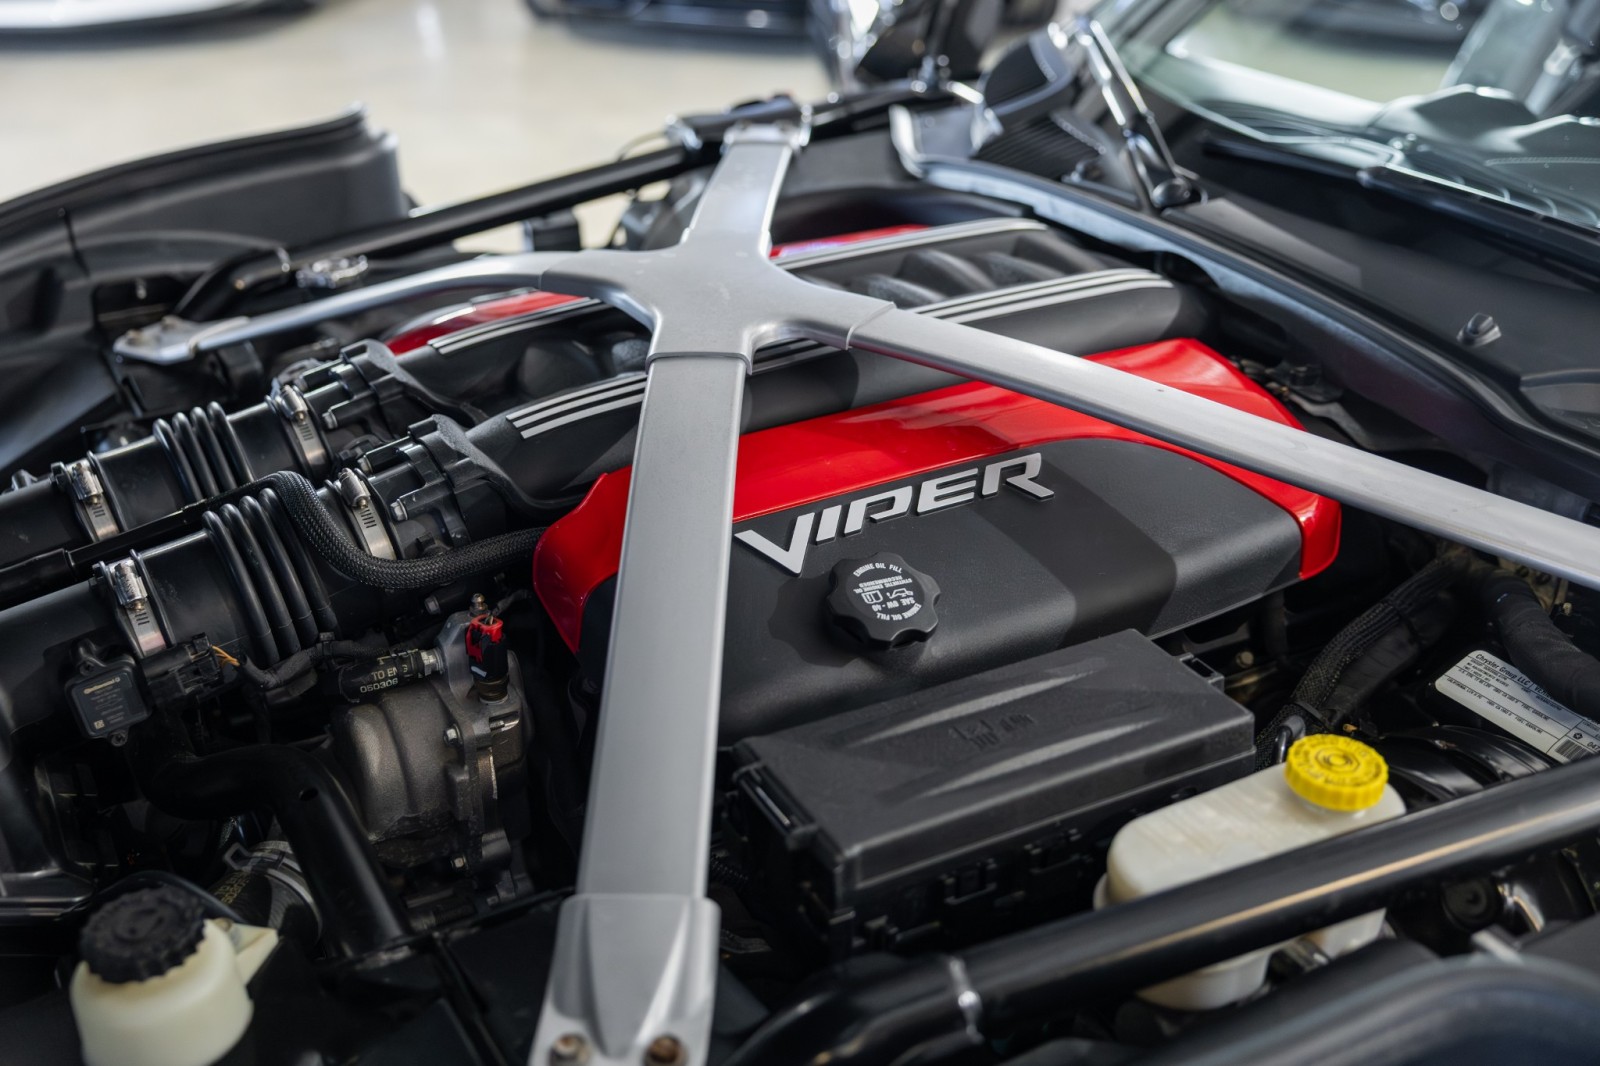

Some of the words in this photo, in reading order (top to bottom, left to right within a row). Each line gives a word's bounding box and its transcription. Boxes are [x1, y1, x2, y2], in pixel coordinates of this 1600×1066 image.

[734, 452, 1055, 576] VIPER
[853, 563, 875, 577] ENGINE
[889, 564, 902, 573] FILL
[859, 575, 903, 587] RECOMMENDED
[884, 578, 912, 587] SYNTHETIC
[863, 584, 883, 592] ENGINE
[900, 597, 915, 605] SAE
[902, 603, 922, 619] ENGINE
[371, 670, 385, 680] TO
[1475, 653, 1500, 669] Chrysler
[1499, 667, 1518, 680] Group
[1517, 676, 1531, 686] LLC
